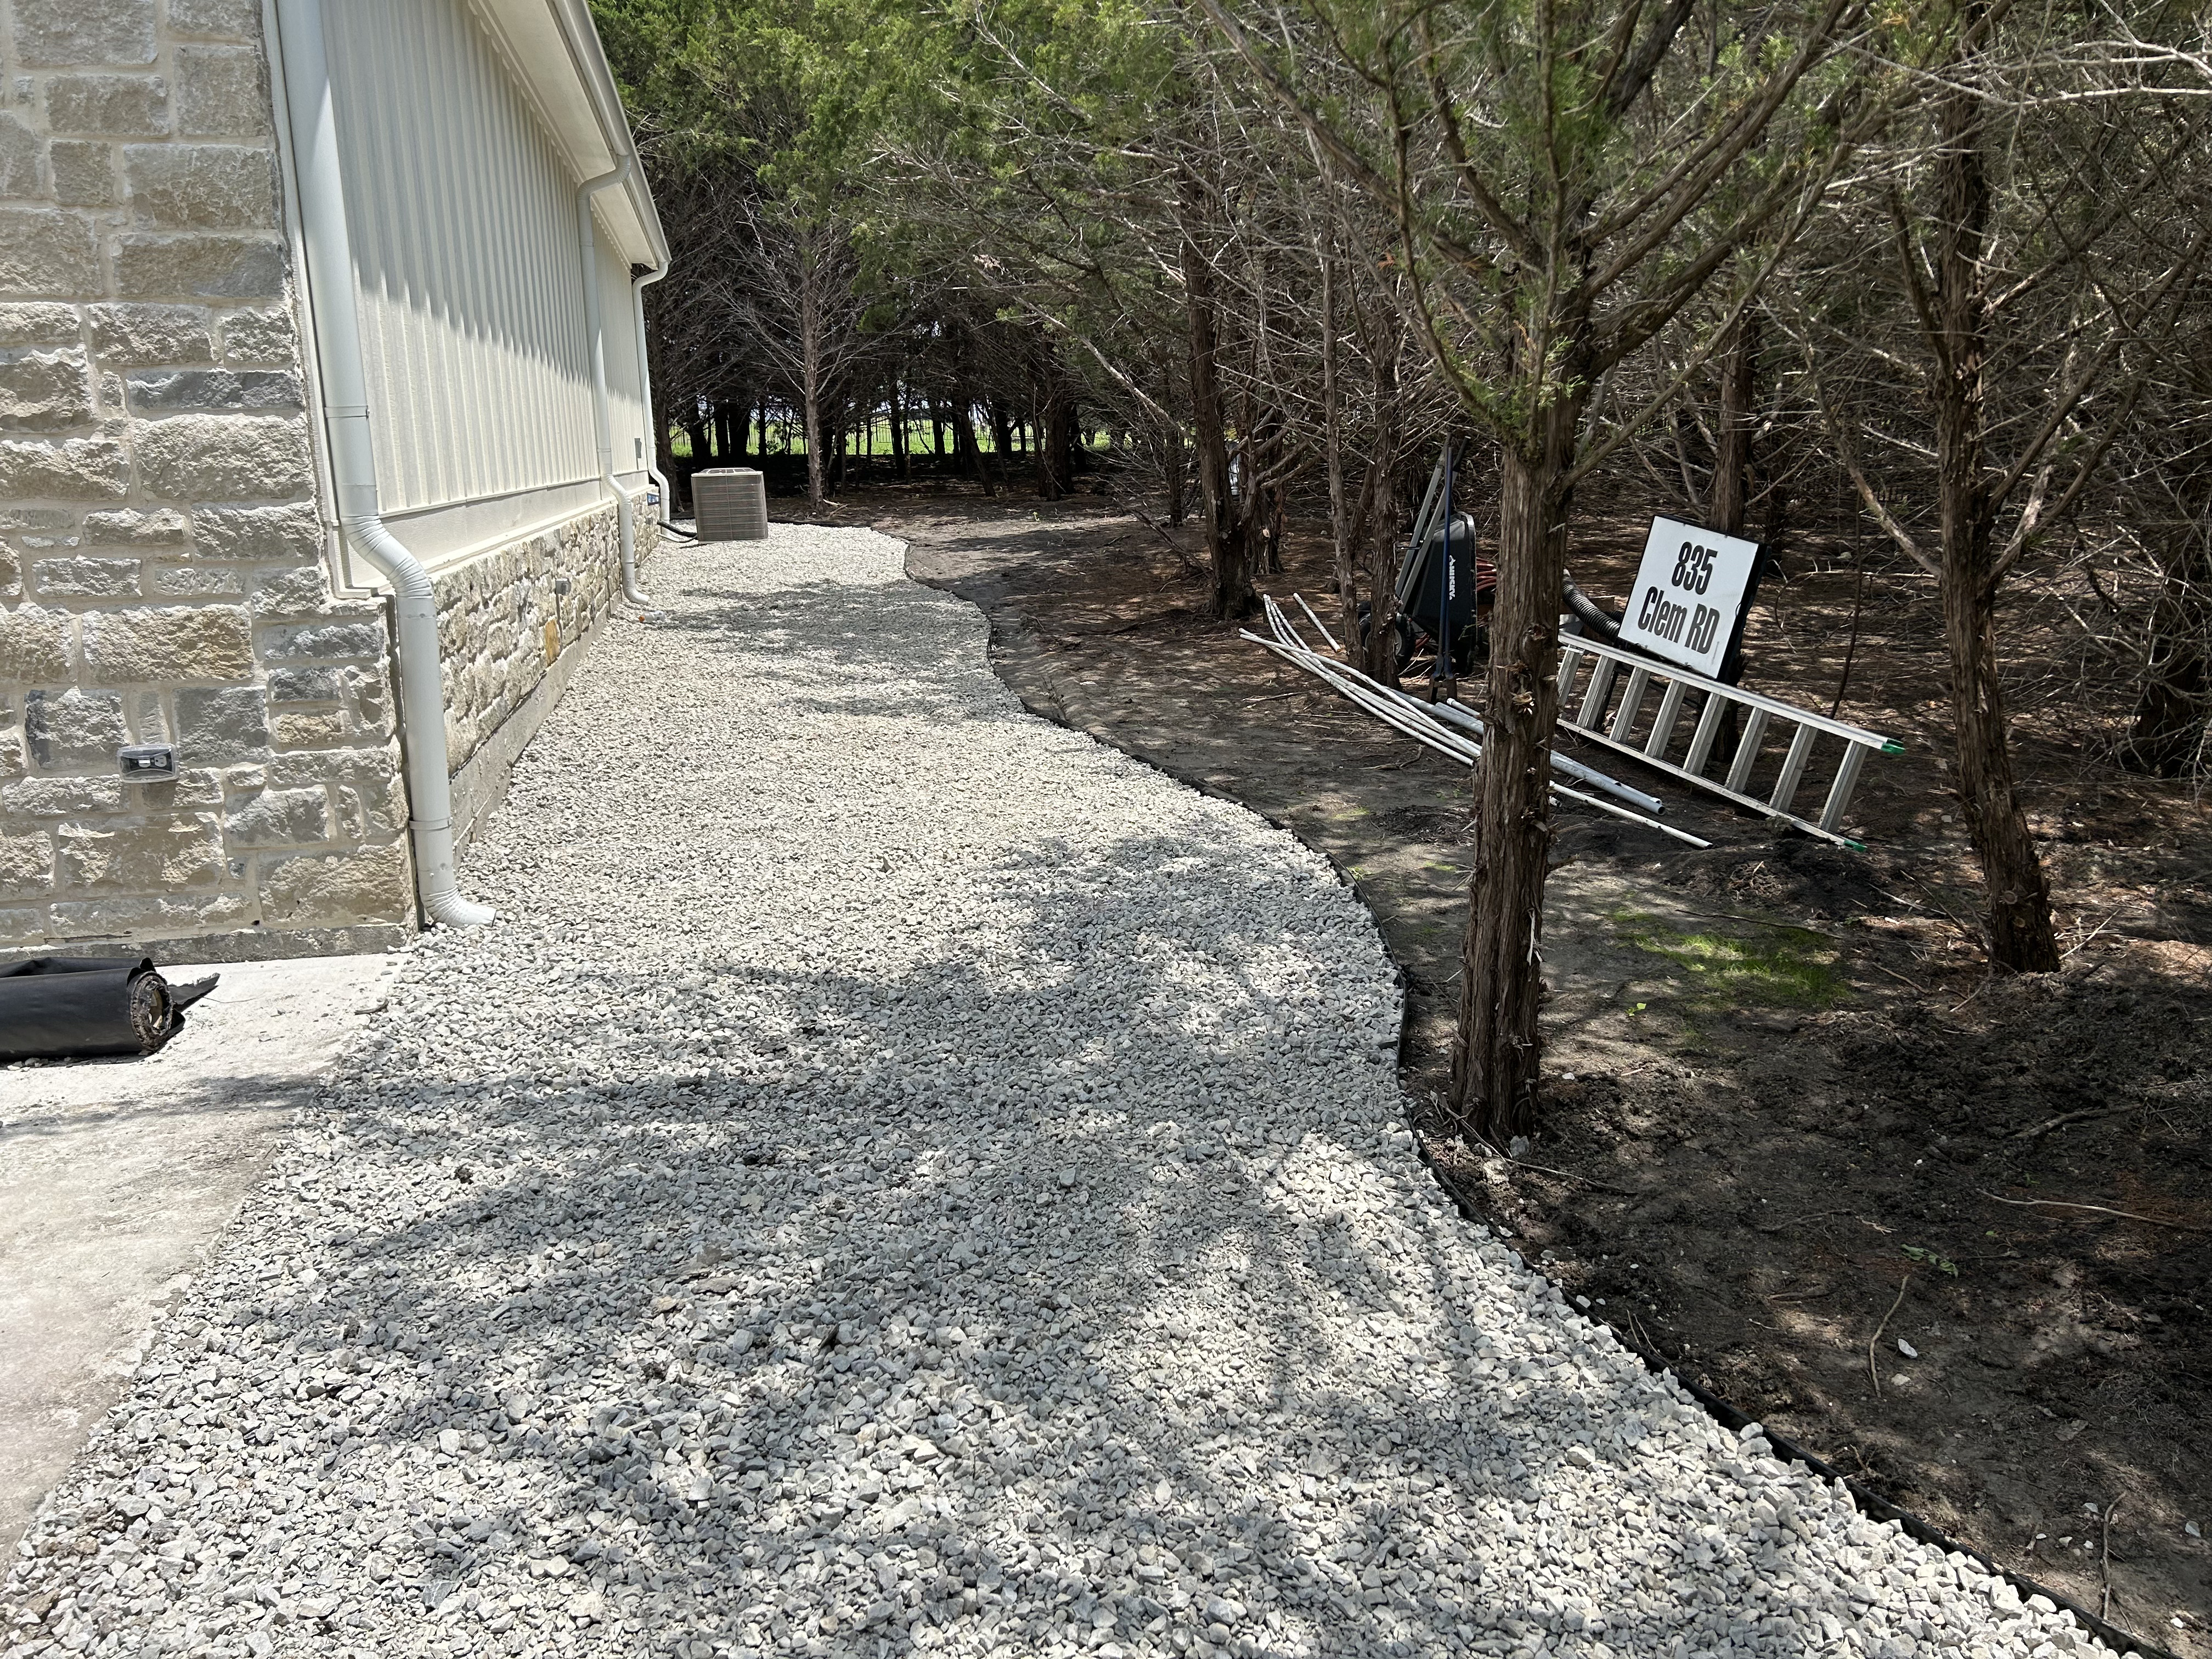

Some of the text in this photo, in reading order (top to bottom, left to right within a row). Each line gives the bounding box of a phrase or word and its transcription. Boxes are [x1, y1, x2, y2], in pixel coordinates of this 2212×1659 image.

[1672, 541, 1718, 595] 835
[1638, 586, 1719, 654] Clem RD
